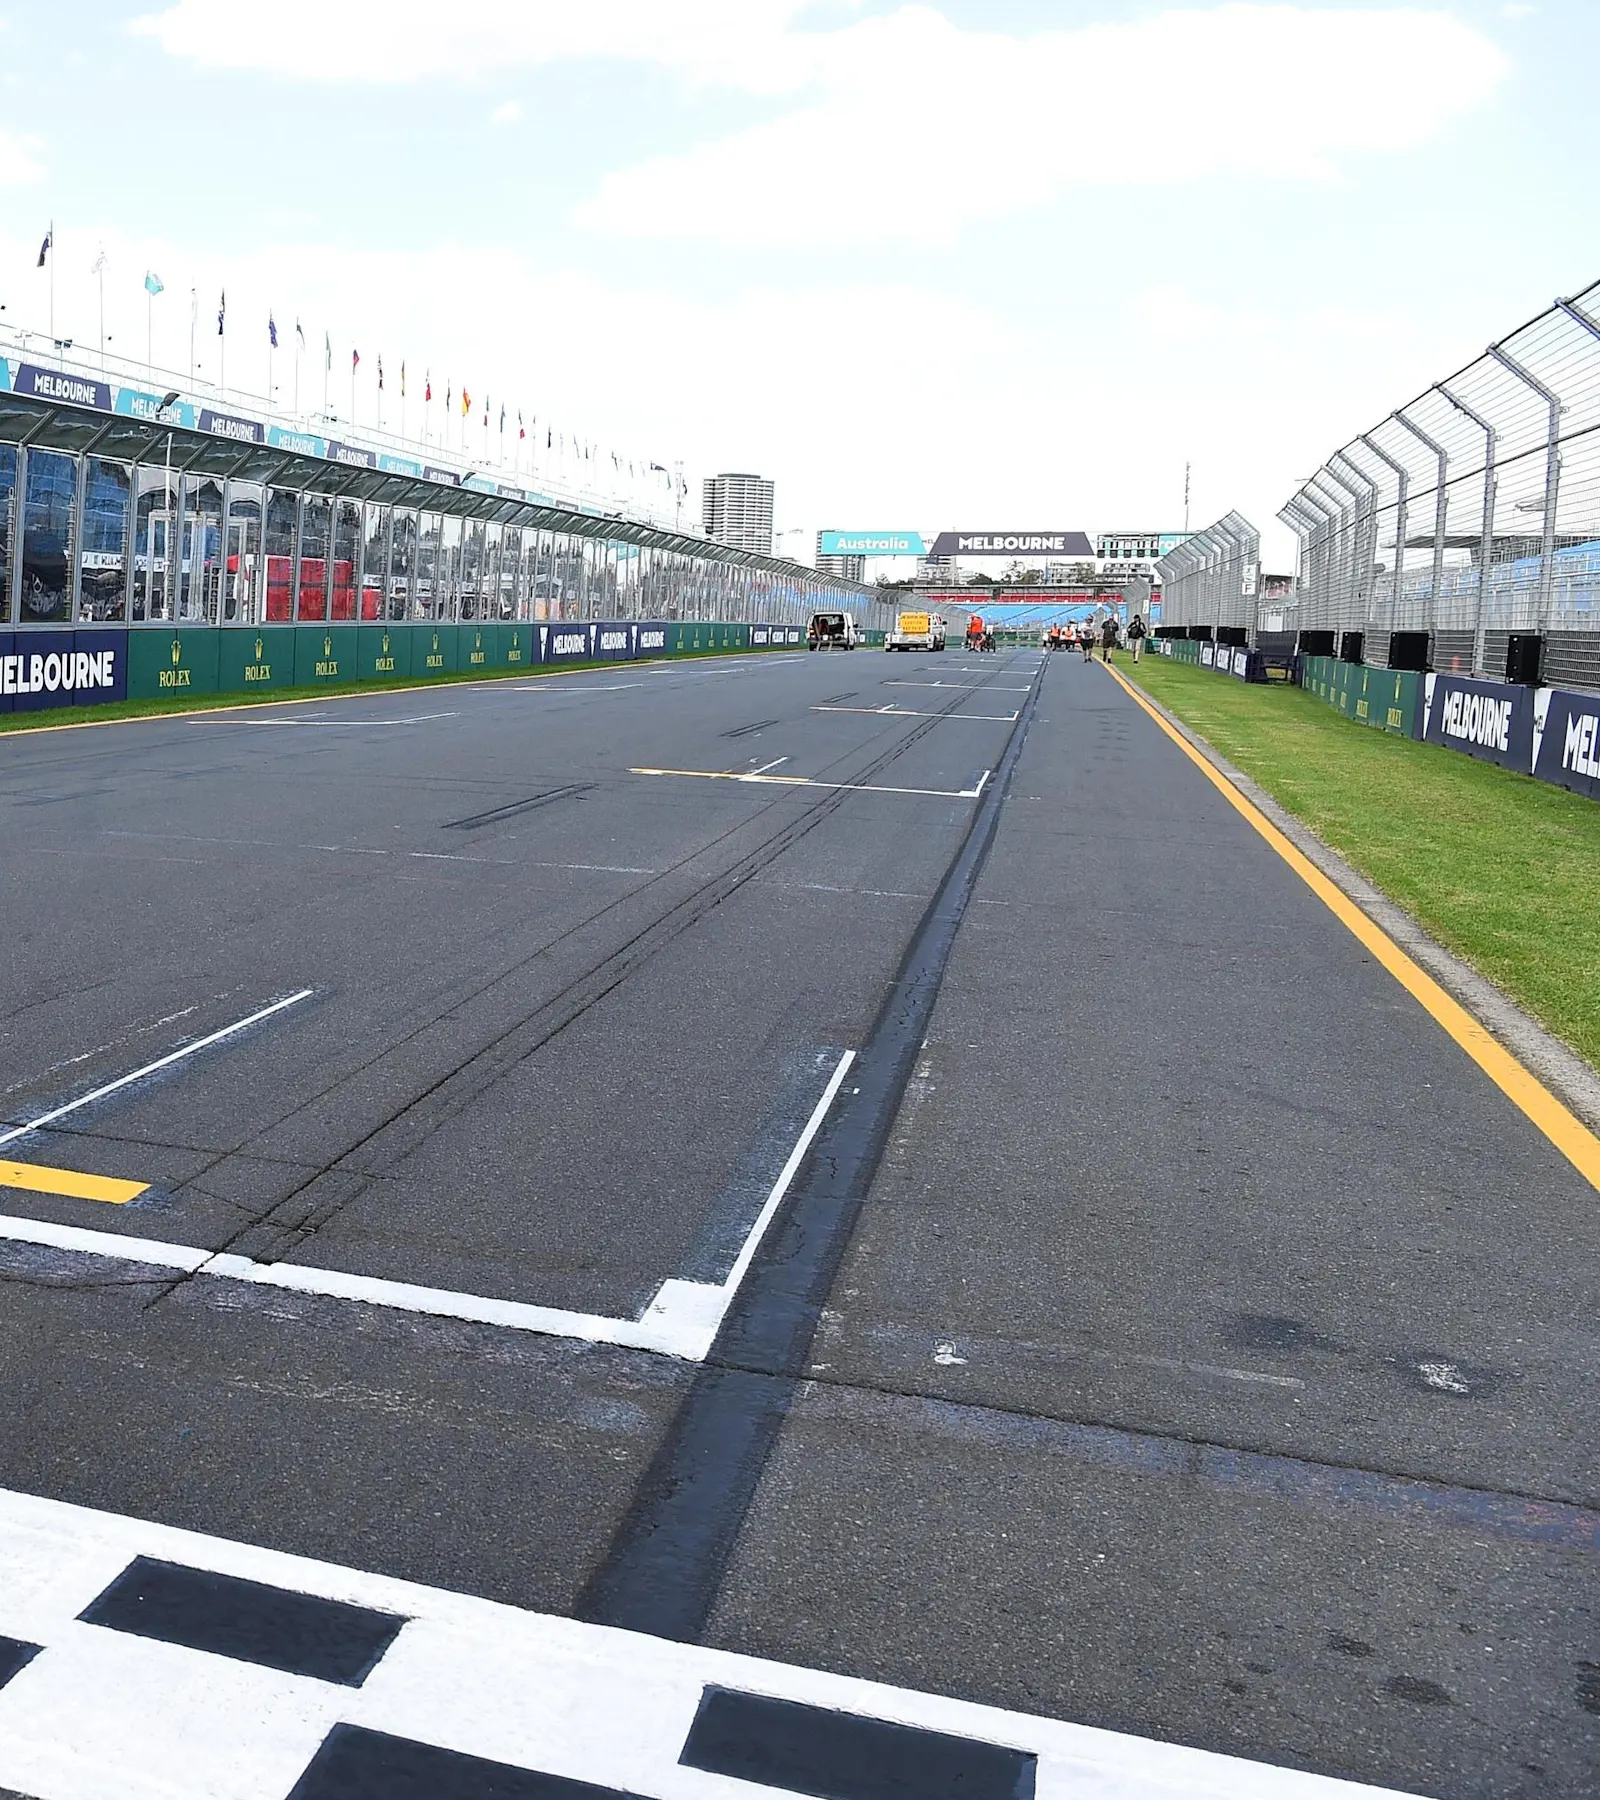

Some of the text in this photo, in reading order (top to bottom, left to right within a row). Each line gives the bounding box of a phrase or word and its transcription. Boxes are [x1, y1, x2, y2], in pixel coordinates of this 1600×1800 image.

[34, 372, 96, 405] MELBOURNE
[131, 397, 182, 424] MELBORNE
[210, 416, 255, 441] MELBOURNE
[836, 537, 909, 550] Australia
[958, 536, 1066, 550] MELBOURNE
[316, 661, 338, 676] ROLEX
[376, 657, 395, 671] ROLEX
[426, 655, 443, 667] ROLEX
[159, 669, 191, 688] ROLEX
[245, 665, 271, 681] ROLEX
[1440, 689, 1513, 752] MELBOURNE
[1562, 711, 1600, 780] MEL
